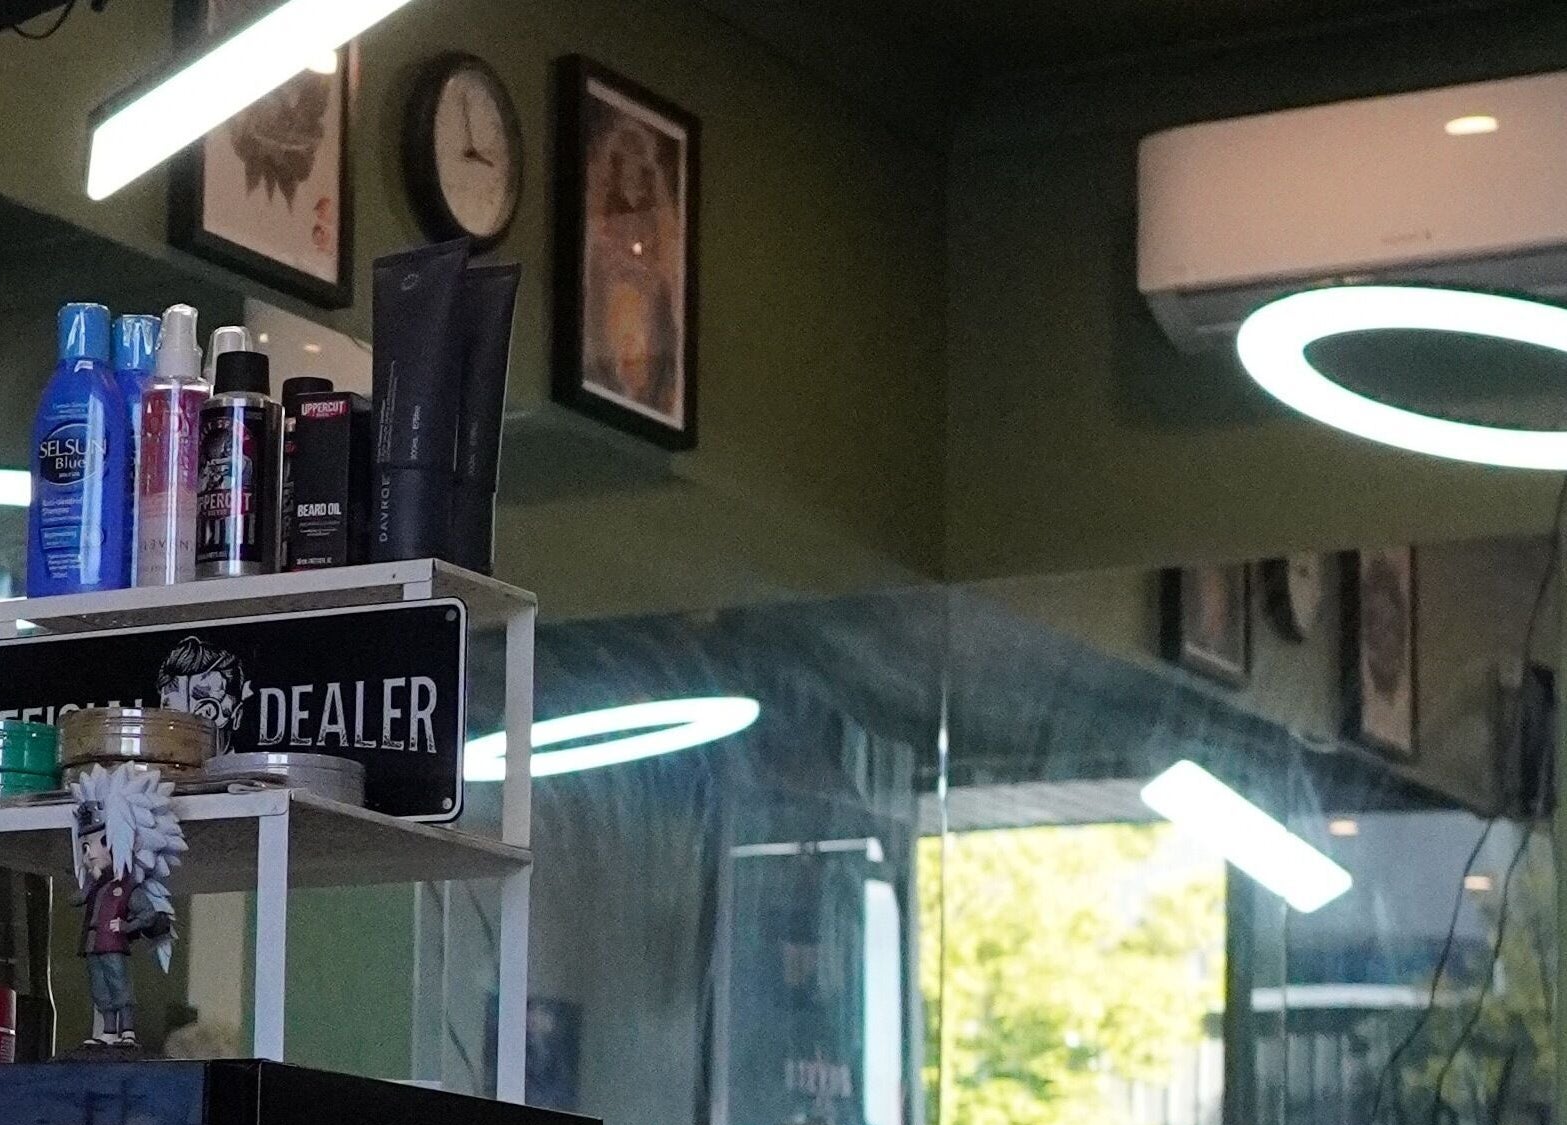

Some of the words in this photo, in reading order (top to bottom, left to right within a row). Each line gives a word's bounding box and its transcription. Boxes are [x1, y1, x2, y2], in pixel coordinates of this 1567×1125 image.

[301, 400, 345, 416] UPPERCUT
[38, 438, 108, 460] SELSUN
[54, 455, 87, 470] Blue
[297, 503, 326, 518] BEARD
[327, 502, 342, 516] OIL
[257, 675, 438, 754] DEALER
